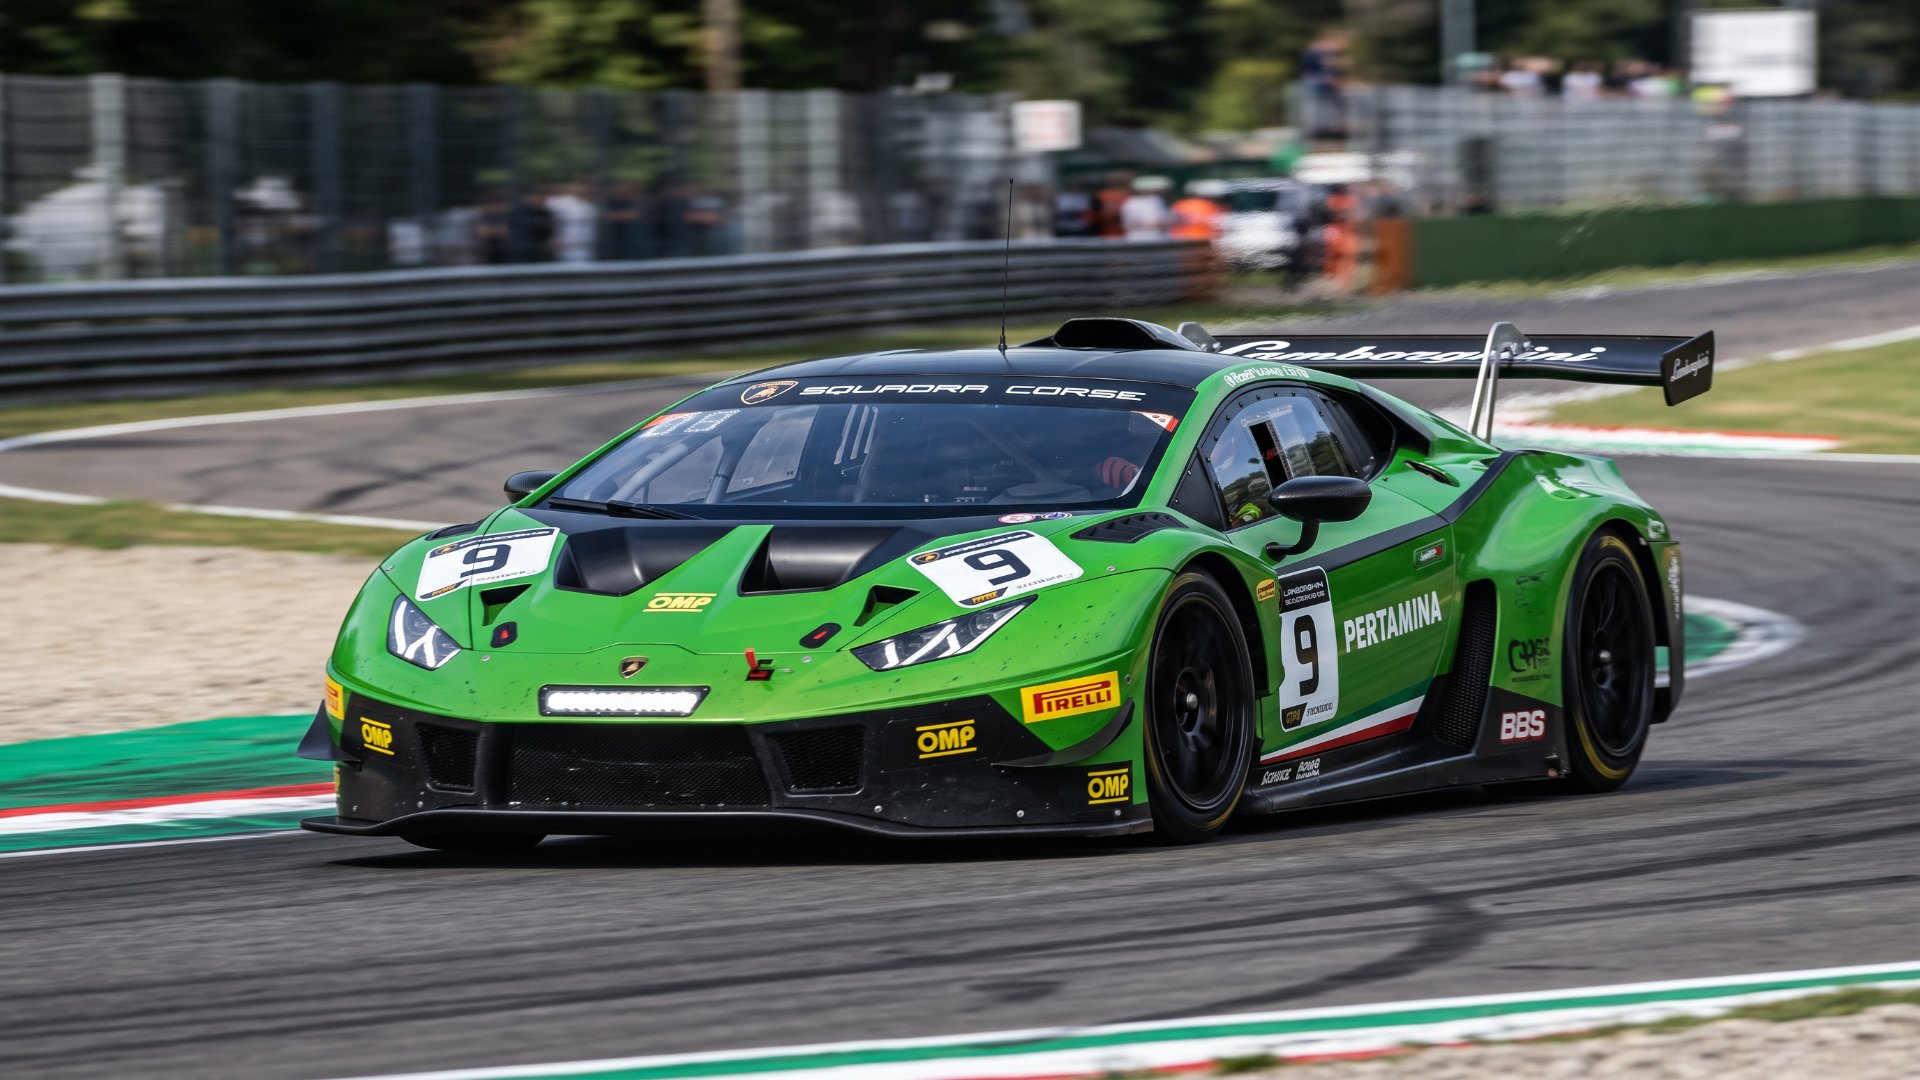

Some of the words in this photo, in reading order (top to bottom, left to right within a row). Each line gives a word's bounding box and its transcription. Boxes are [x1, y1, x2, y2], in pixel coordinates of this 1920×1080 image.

[799, 384, 989, 397] SQUADRA
[1005, 385, 1147, 401] CORSE
[460, 543, 512, 578] 9
[963, 549, 1031, 587] 9
[647, 596, 713, 609] OMP
[1343, 590, 1443, 653] PERTAMINA
[1293, 614, 1320, 697] 9
[1032, 680, 1112, 715] PIRELLI
[361, 723, 393, 749] OMP
[917, 725, 976, 753] OMP
[1500, 709, 1546, 741] BBS
[1087, 774, 1129, 799] OMP
